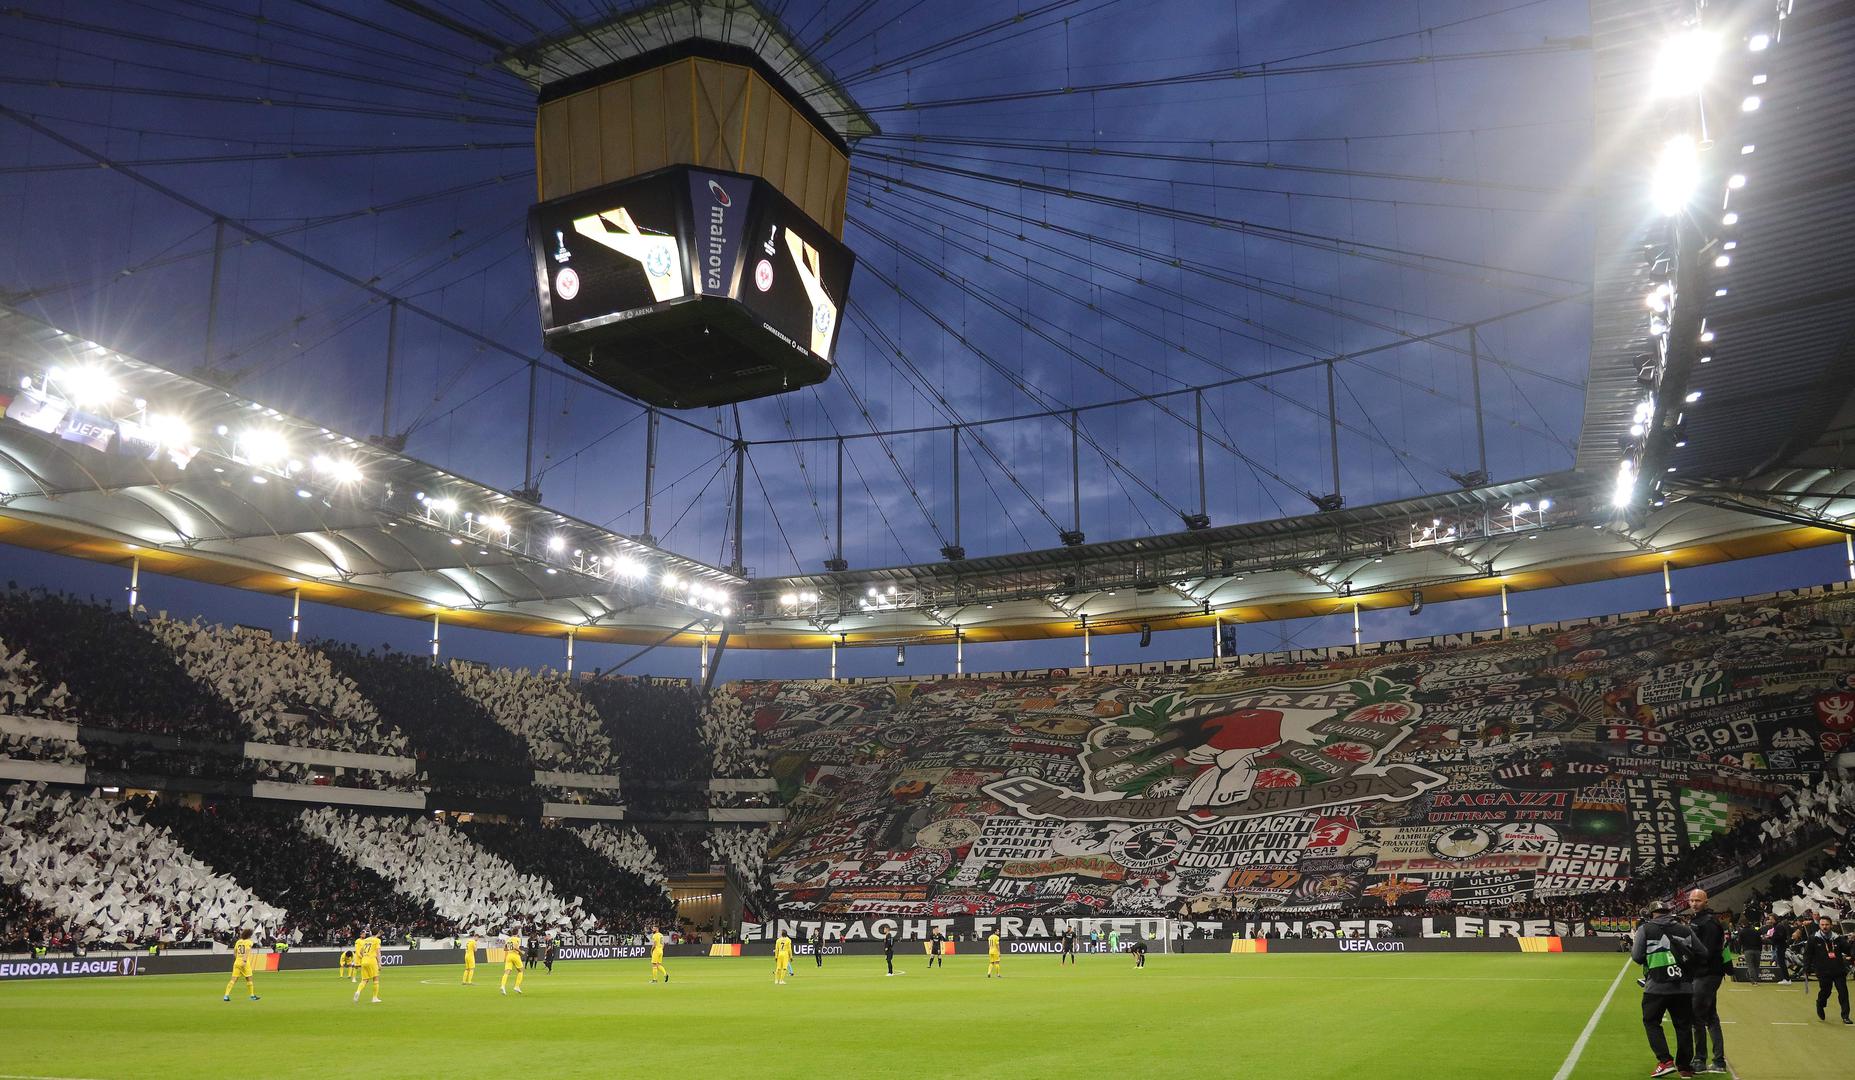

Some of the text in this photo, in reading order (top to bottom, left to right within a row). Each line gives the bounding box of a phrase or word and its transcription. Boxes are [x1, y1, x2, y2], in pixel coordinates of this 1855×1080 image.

[708, 206, 726, 289] mainova
[68, 419, 108, 443] UEFA
[1112, 737, 1161, 759] DEM
[1290, 748, 1345, 775] GUTEN
[1218, 790, 1248, 803] UF
[1248, 779, 1372, 811] SEIT 1997
[1430, 792, 1569, 808] RAGAZZI
[1319, 805, 1362, 817] UF97
[1427, 809, 1563, 823] ULTRAS FFM
[985, 818, 1064, 828] EHRE DER
[1131, 822, 1184, 834] INFERNO
[982, 828, 1055, 838] GRUPPE
[976, 837, 1053, 848] STADION
[1186, 832, 1309, 853] FRANKFURT
[973, 847, 1049, 859] VERBOT
[1304, 846, 1338, 855] ACAB
[1543, 841, 1631, 863] BESSER
[1177, 850, 1302, 868] HOOLIGANS
[1547, 858, 1618, 877] RENN
[1264, 870, 1302, 889] 97
[1470, 873, 1521, 886] ULTRAS
[988, 876, 1076, 898] ULT RAS
[1474, 885, 1516, 897] NEVER
[852, 901, 927, 914] ultras
[740, 917, 955, 941] EINTRACHT
[974, 916, 1223, 941] FRANKFURT
[363, 943, 372, 953] 27
[1011, 942, 1079, 953] DOWNLOD
[1340, 939, 1405, 951] UEFA.com
[559, 946, 646, 959] DOWNLOAD THE APP
[0, 960, 118, 976] EUROPA LEAGUE
[1666, 964, 1683, 978] 03
